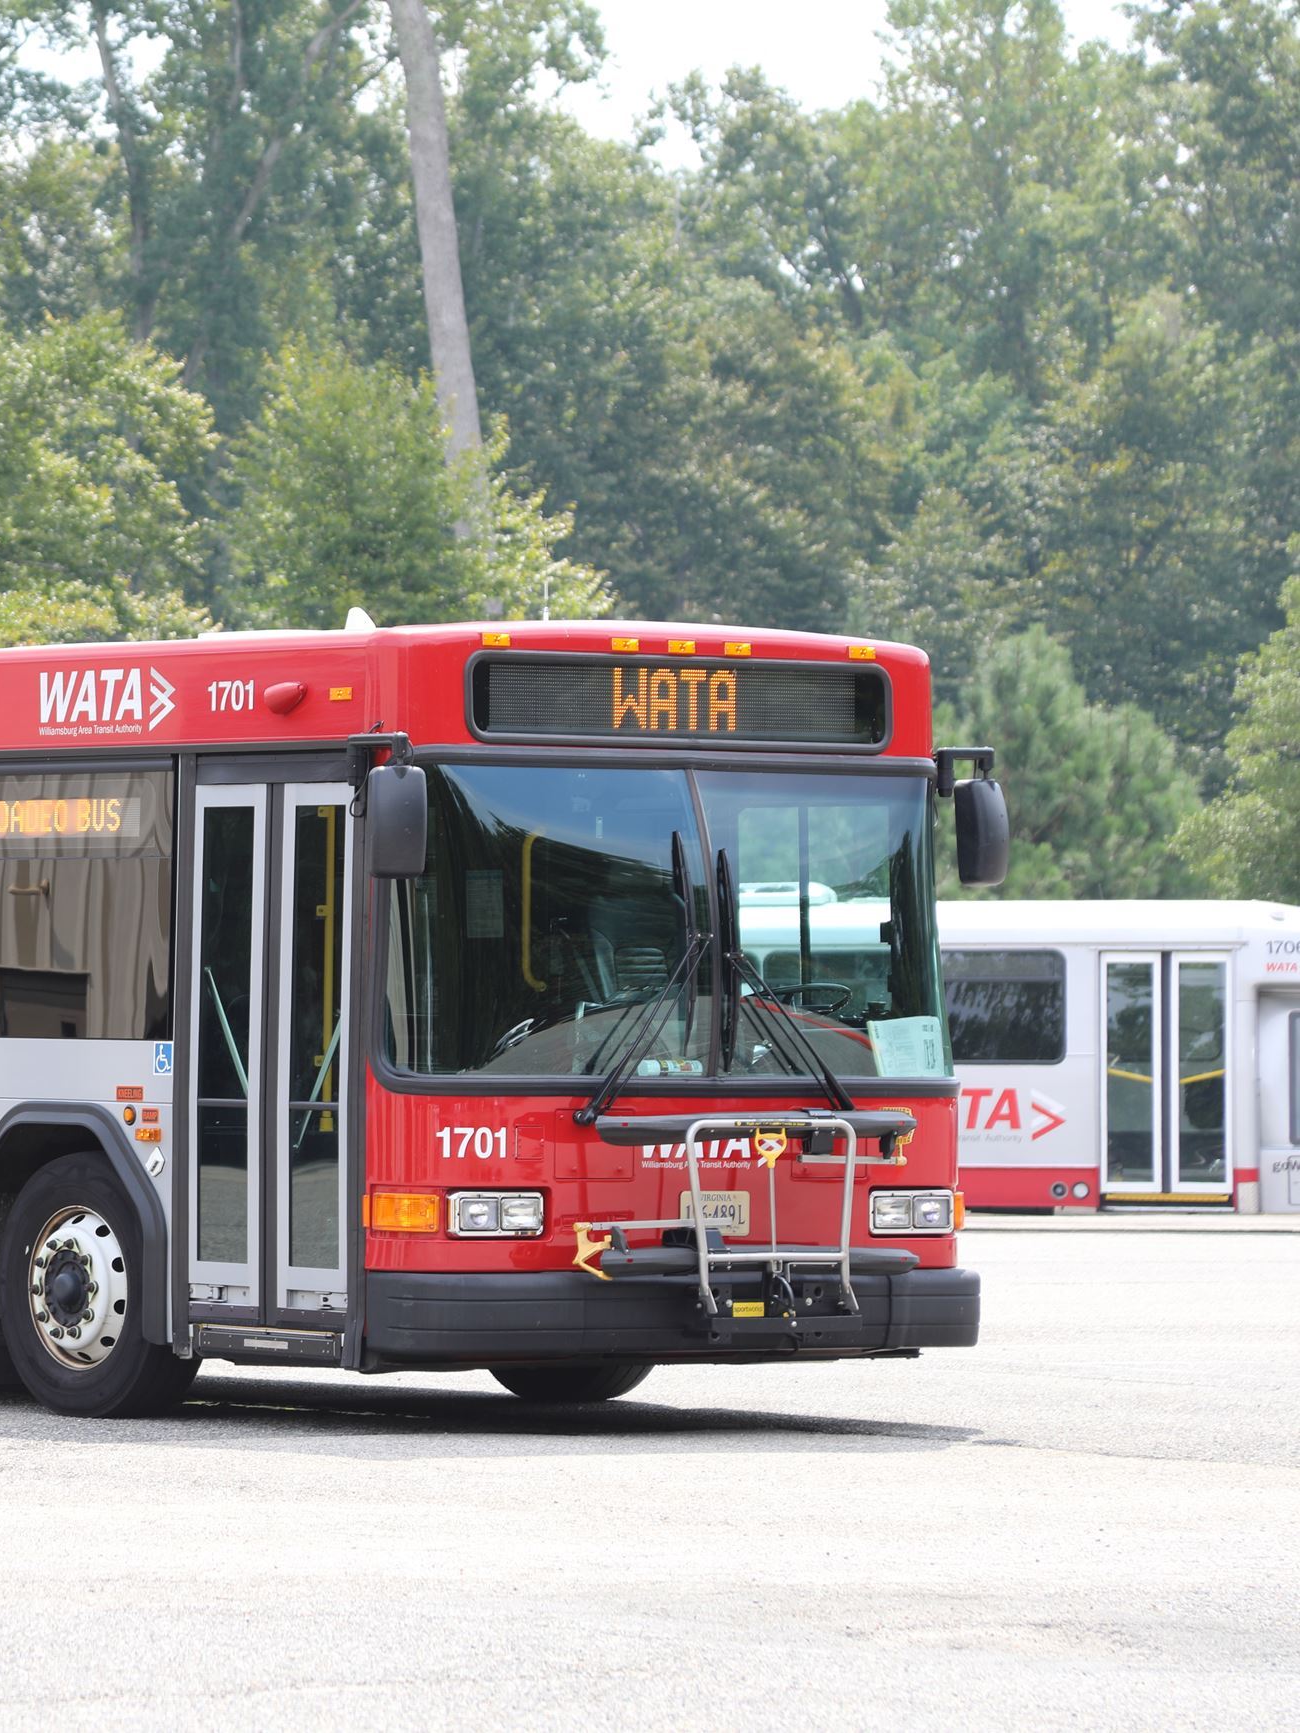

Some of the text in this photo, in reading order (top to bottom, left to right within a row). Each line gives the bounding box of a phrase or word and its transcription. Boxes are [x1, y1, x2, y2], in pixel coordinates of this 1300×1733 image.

[39, 668, 143, 723] WATA
[207, 679, 255, 712] 1701
[613, 667, 737, 731] WATA
[39, 724, 142, 737] Williamsburg Area Transit Authority
[76, 798, 121, 832] BUS
[436, 1126, 507, 1159] 1701
[642, 1161, 683, 1170] Williamsburg
[701, 1161, 722, 1169] Transit
[723, 1161, 751, 1170] Authority
